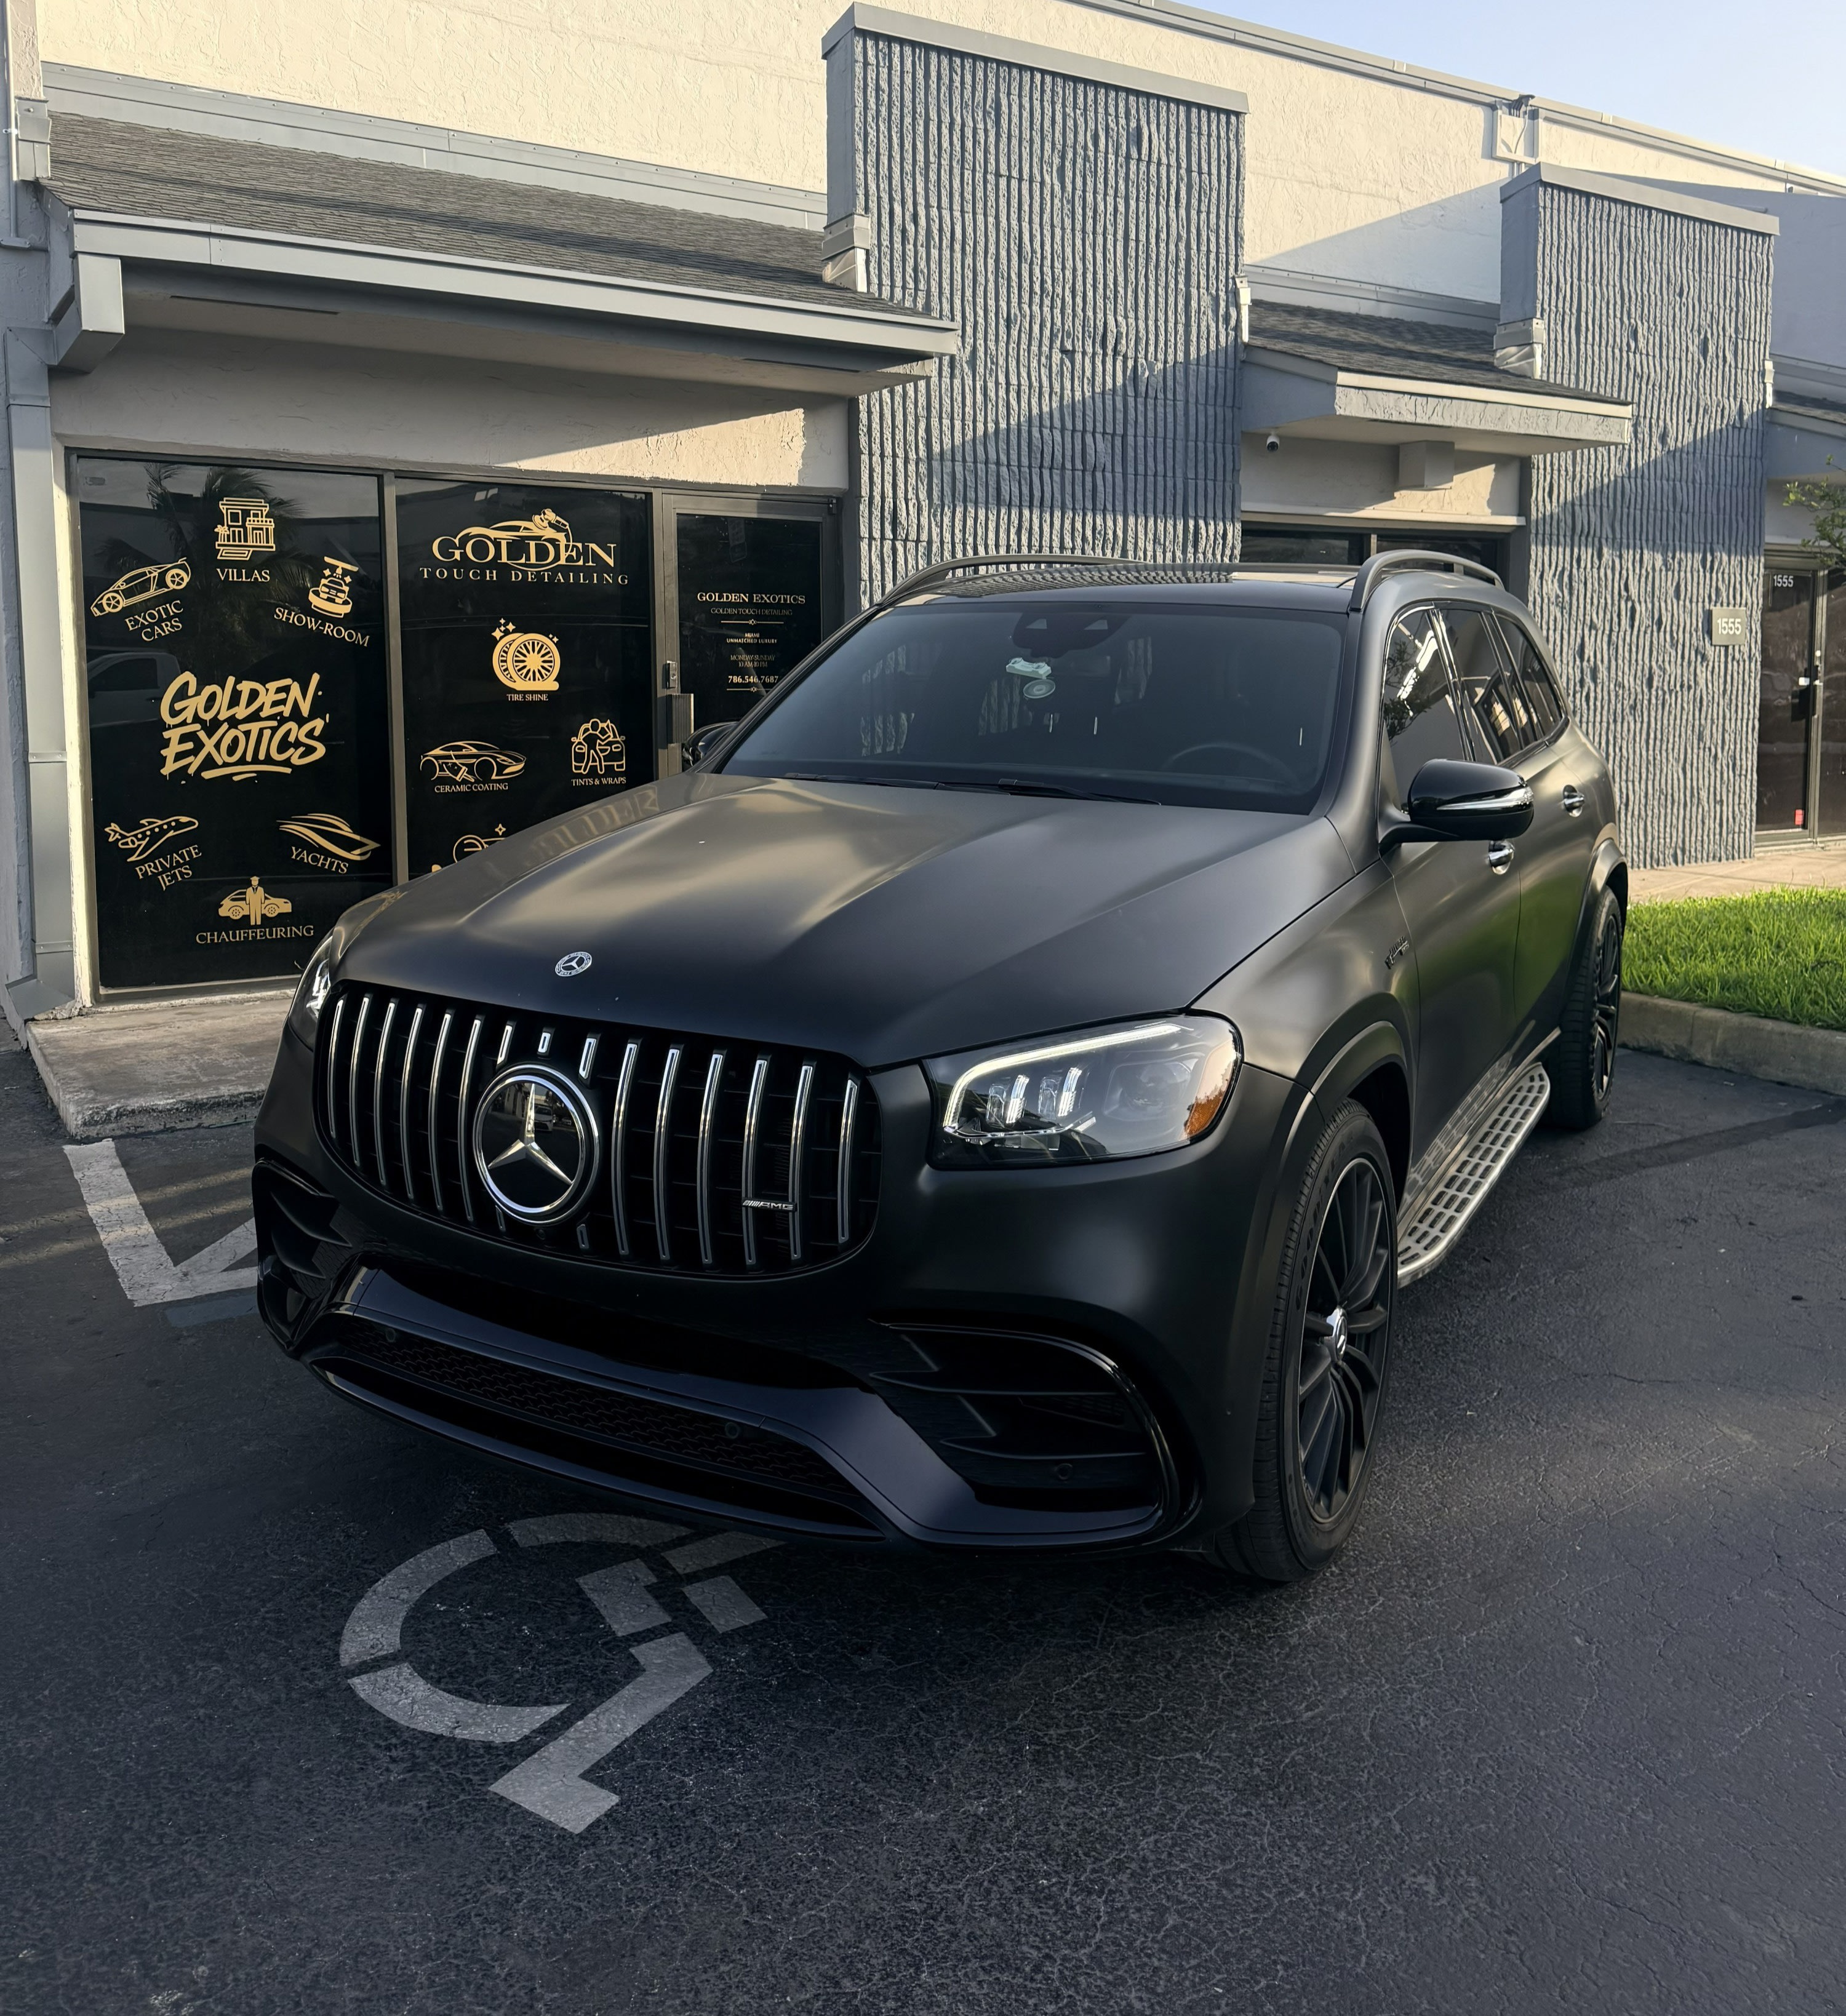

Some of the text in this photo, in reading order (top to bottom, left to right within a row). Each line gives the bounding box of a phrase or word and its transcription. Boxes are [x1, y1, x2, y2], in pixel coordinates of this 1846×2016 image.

[432, 535, 617, 567] GOLDEN
[216, 568, 270, 582] VILLAS
[419, 567, 628, 584] TOUCH DETAILING
[1773, 575, 1794, 588] 1555
[697, 592, 805, 604] GOLDEN EXOTICS
[125, 600, 183, 631] EXOTIC
[274, 607, 370, 647] SHOW-ROOM
[1717, 618, 1741, 635] 1555
[141, 618, 183, 642] CARS
[160, 671, 320, 726] GOLDEN
[160, 717, 326, 778] EXOTICS
[434, 783, 508, 793] CERAMIC COATING
[135, 845, 202, 880] PRIVATE
[290, 846, 348, 874] YACHTS
[157, 865, 193, 891] JETS
[196, 925, 314, 945] CHAUFFEURING
[757, 1201, 794, 1210] AMG
